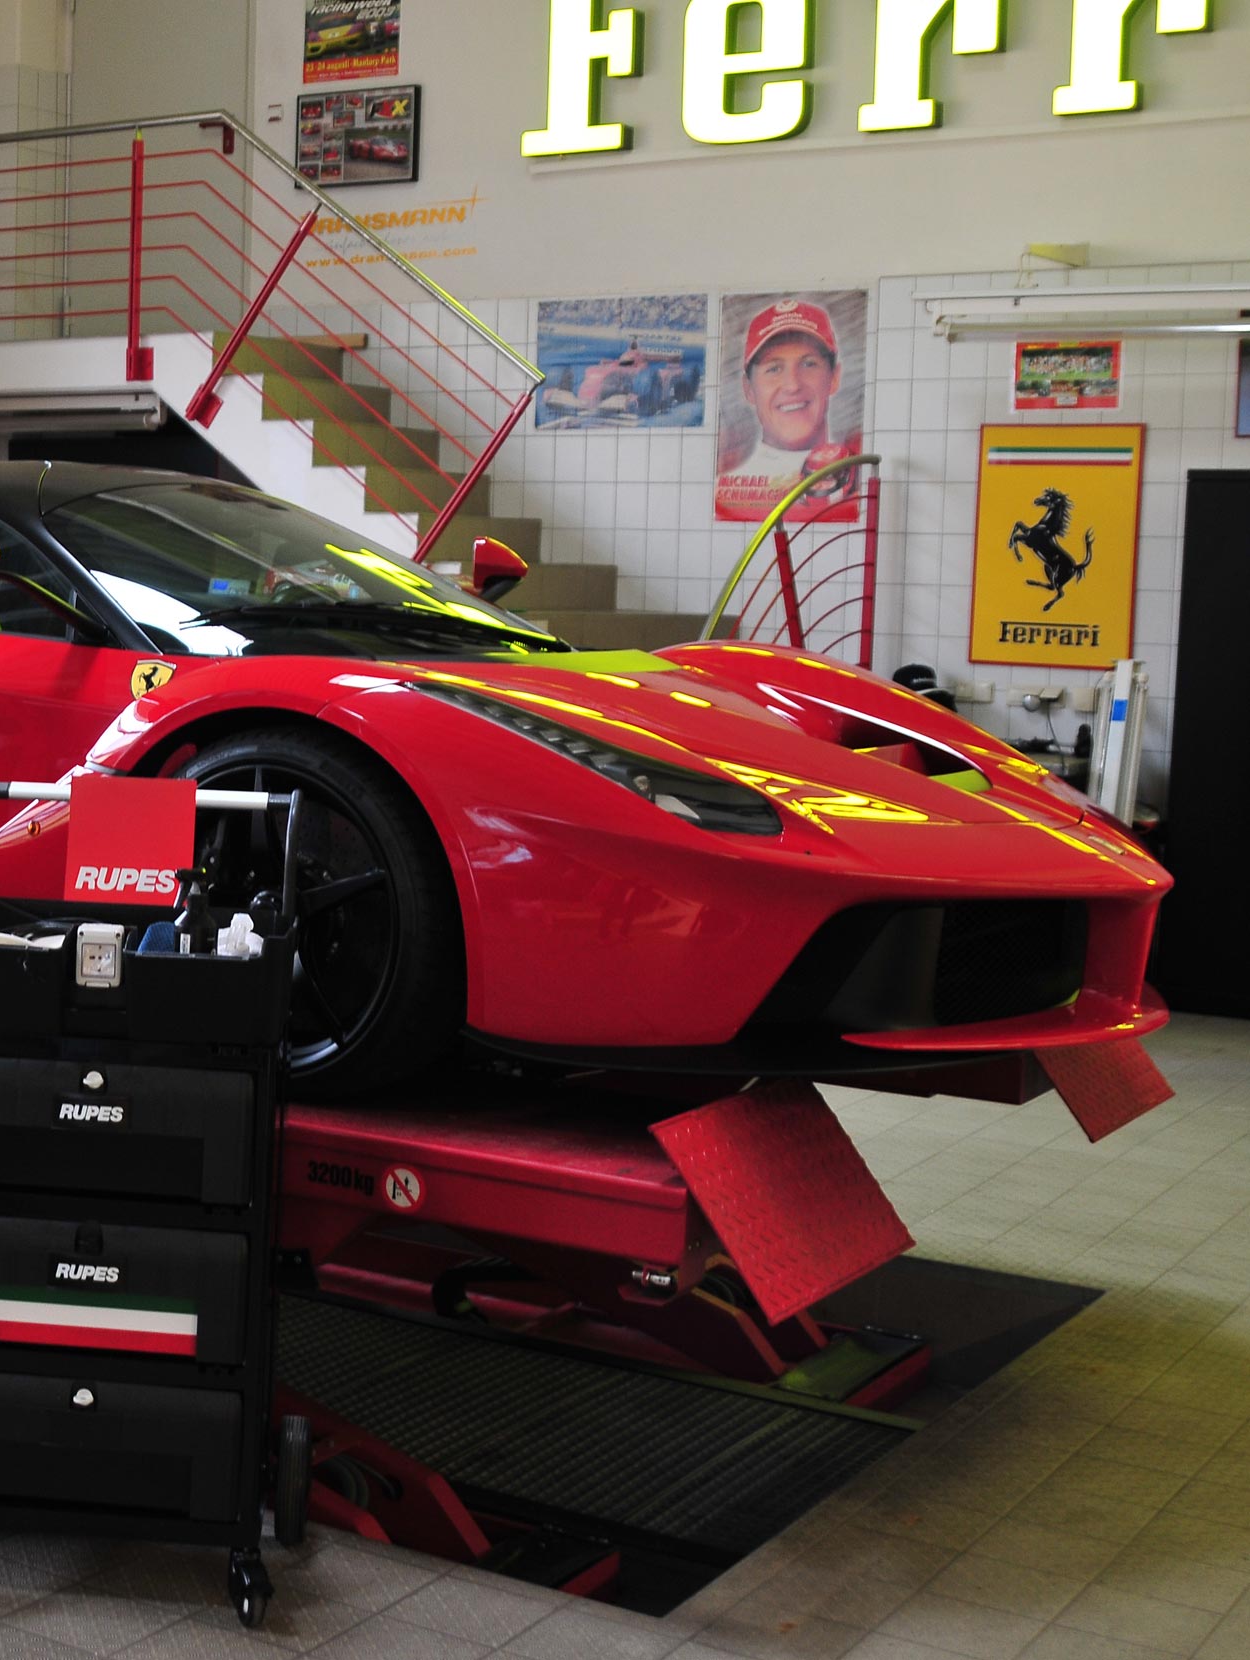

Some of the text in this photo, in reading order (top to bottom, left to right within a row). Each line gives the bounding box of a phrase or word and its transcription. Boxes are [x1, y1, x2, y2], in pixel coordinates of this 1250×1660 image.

[999, 621, 1100, 647] Ferrari
[75, 866, 175, 893] RUPES
[59, 1103, 123, 1122] RUPES
[308, 1160, 375, 1197] 3200 kg
[55, 1264, 119, 1283] RUPES
